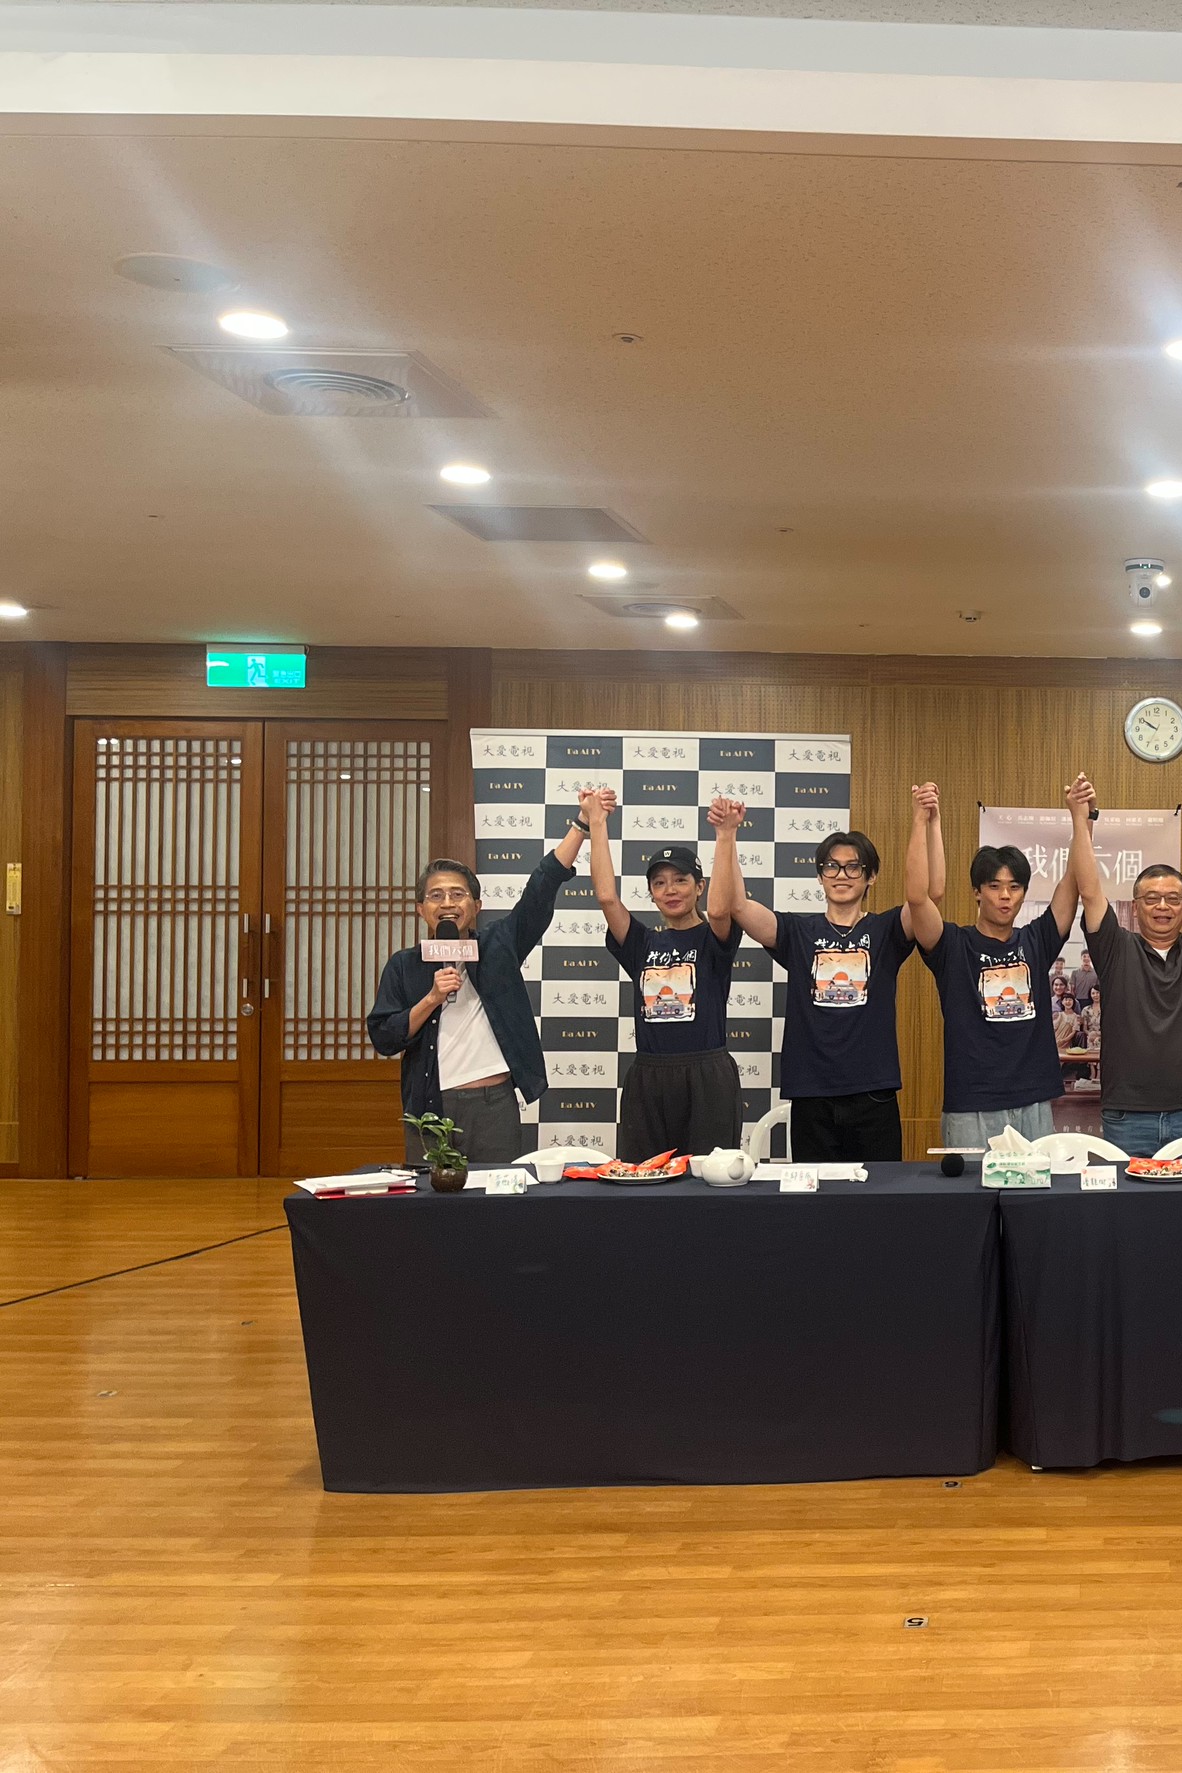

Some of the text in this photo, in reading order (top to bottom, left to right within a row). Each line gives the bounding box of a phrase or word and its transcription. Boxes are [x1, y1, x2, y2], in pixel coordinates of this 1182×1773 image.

[481, 744, 535, 758] 大愛電視
[633, 745, 686, 760] 大愛電視
[788, 748, 841, 762] 大愛電視
[711, 782, 764, 796] 大愛電視
[481, 814, 533, 828] 大愛電視
[632, 816, 685, 830] 大愛電視
[787, 818, 841, 832] 大愛電視
[787, 889, 825, 902] 大愛電
[553, 922, 608, 935] 大愛電視
[428, 944, 473, 956] 我們六個
[552, 992, 607, 1005] 大愛電視
[551, 1063, 606, 1077] 大愛電視
[549, 1134, 604, 1147] 大愛電視
